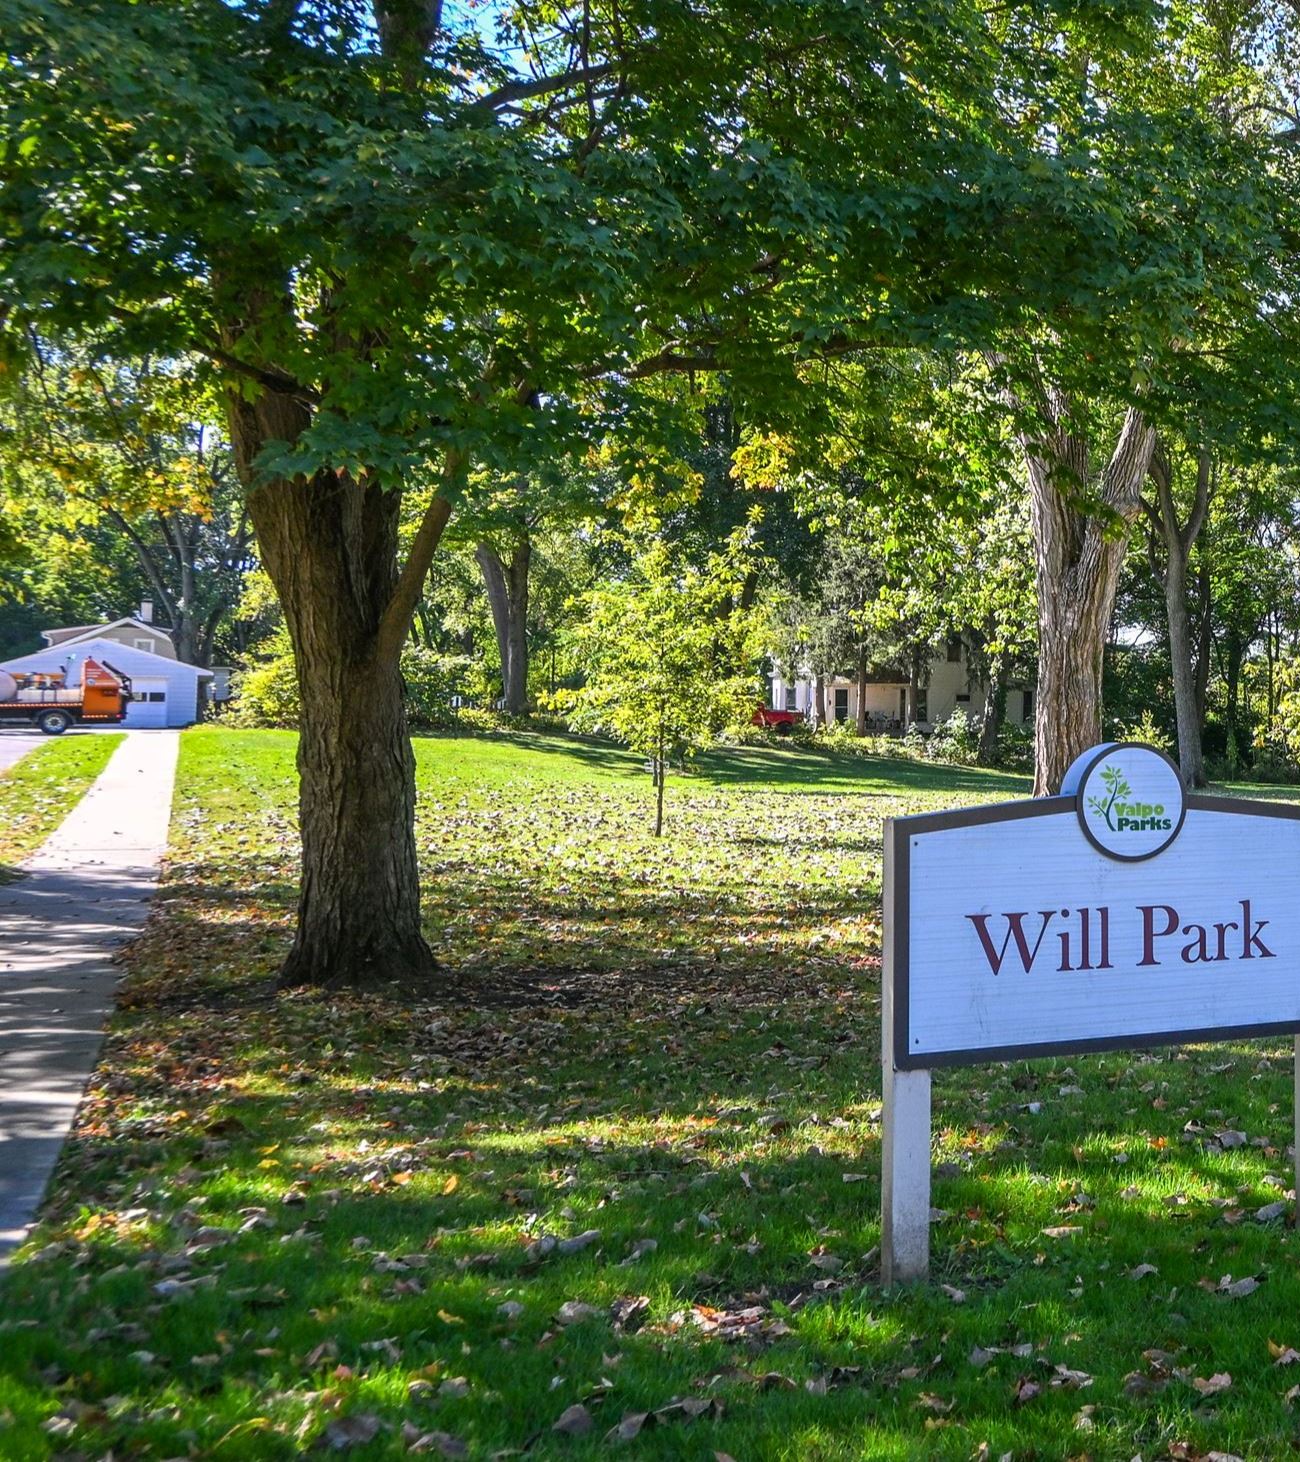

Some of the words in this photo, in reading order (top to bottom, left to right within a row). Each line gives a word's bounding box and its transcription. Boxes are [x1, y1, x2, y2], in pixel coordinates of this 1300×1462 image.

[1114, 803, 1165, 818] Valpo
[1117, 817, 1172, 832] Parks
[964, 906, 1114, 976] Will
[1135, 899, 1277, 966] Park
